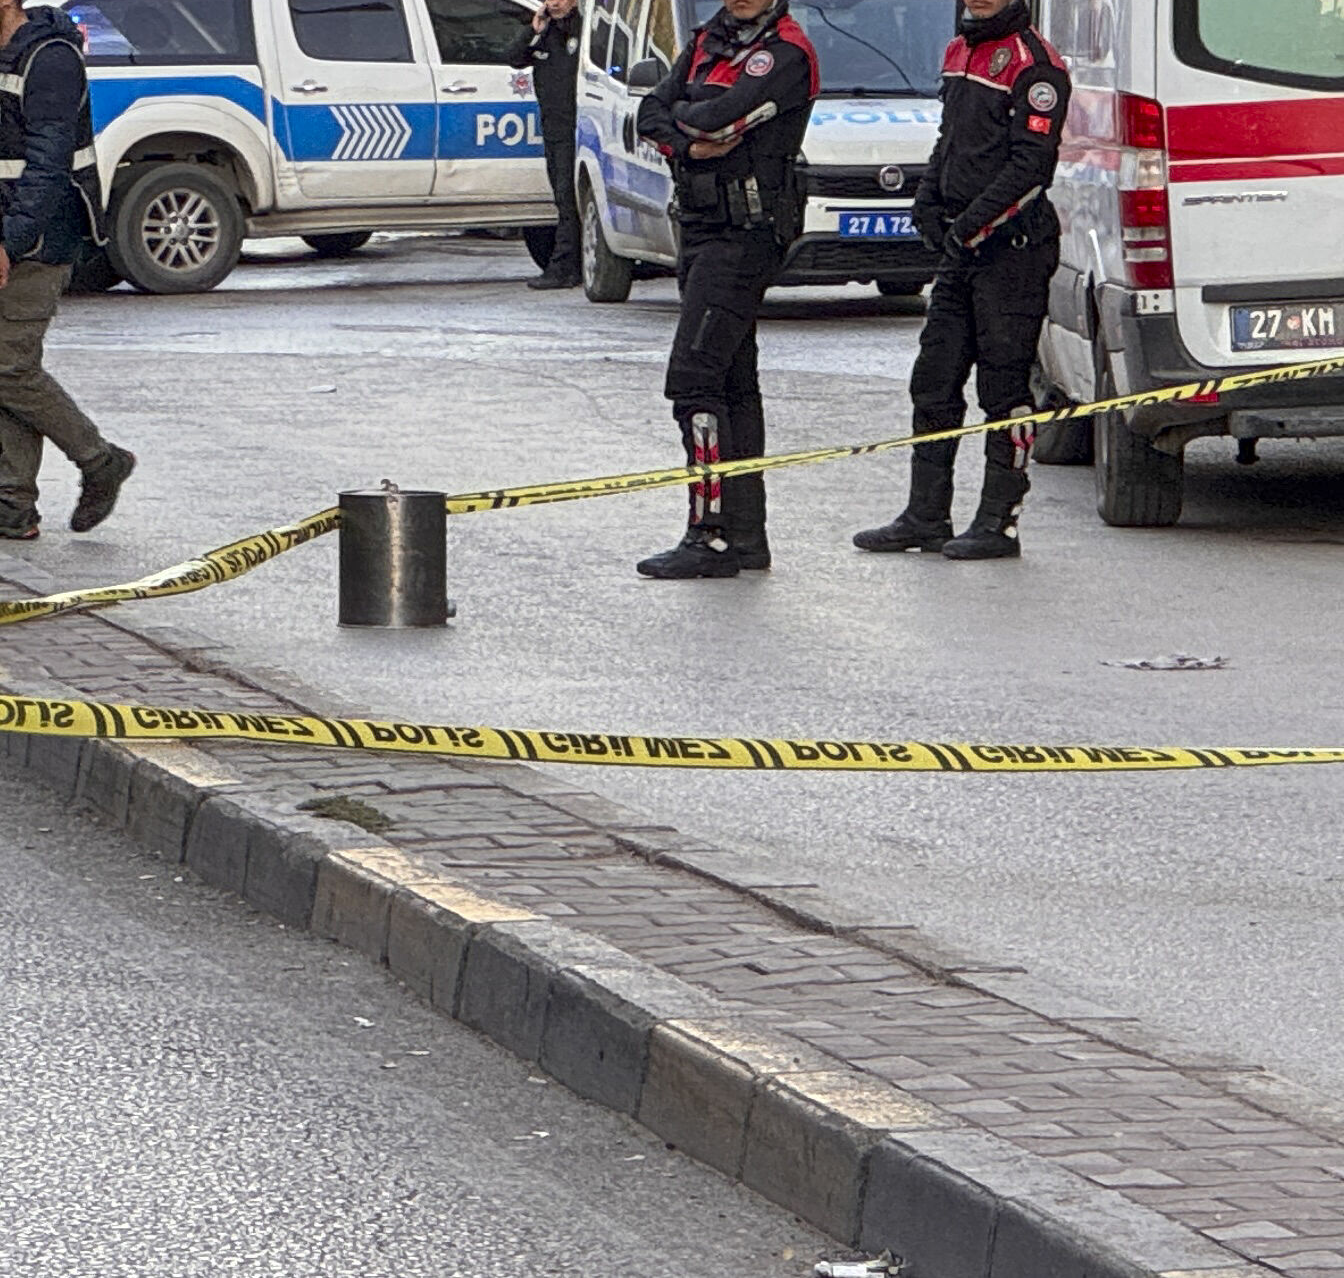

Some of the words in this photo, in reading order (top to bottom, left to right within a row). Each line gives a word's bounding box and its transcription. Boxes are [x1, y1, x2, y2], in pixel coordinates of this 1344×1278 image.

[848, 217, 867, 235] 27
[873, 217, 885, 234] A
[1249, 309, 1283, 339] 27
[1301, 307, 1335, 337] KM
